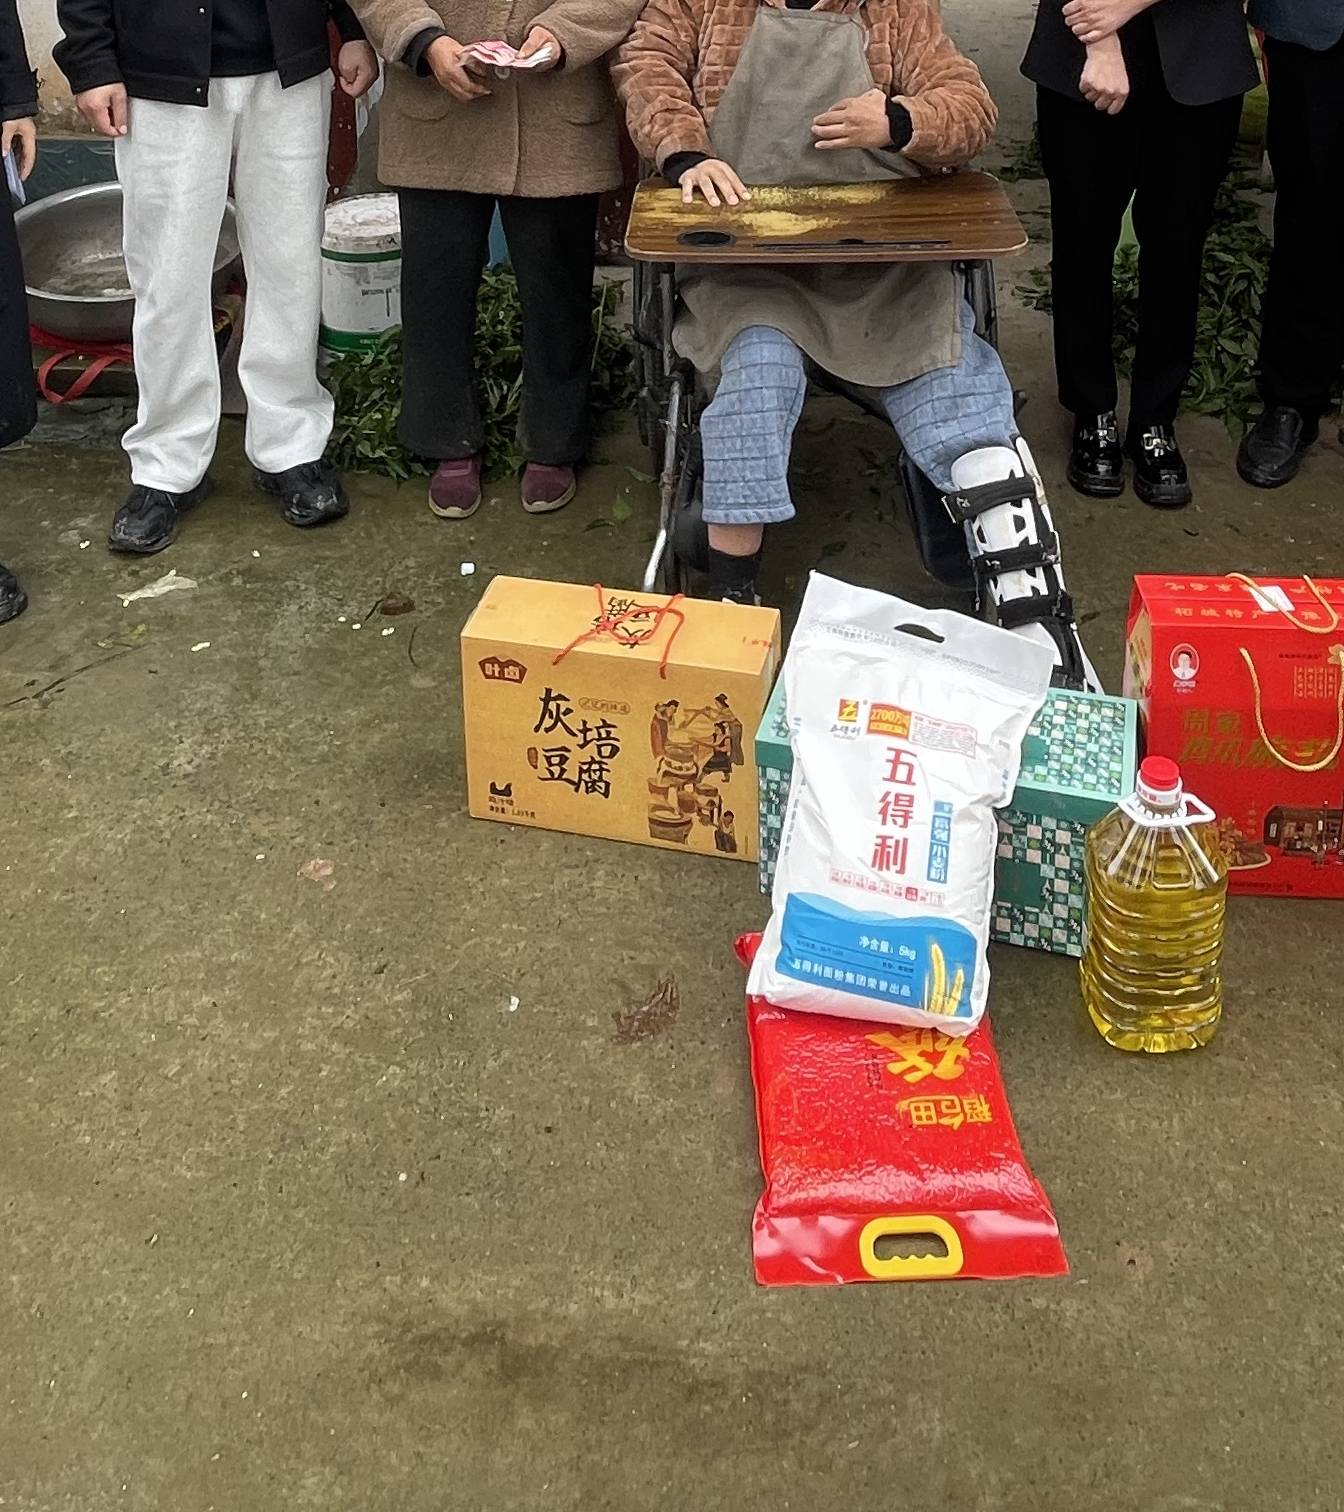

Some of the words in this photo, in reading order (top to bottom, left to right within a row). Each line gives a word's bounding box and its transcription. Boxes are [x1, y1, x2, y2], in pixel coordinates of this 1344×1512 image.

[532, 686, 622, 761] 灰培
[536, 745, 612, 799] 豆腐
[870, 746, 920, 876] 五得利
[792, 957, 912, 997] 五得利面粉集团荣誉出品
